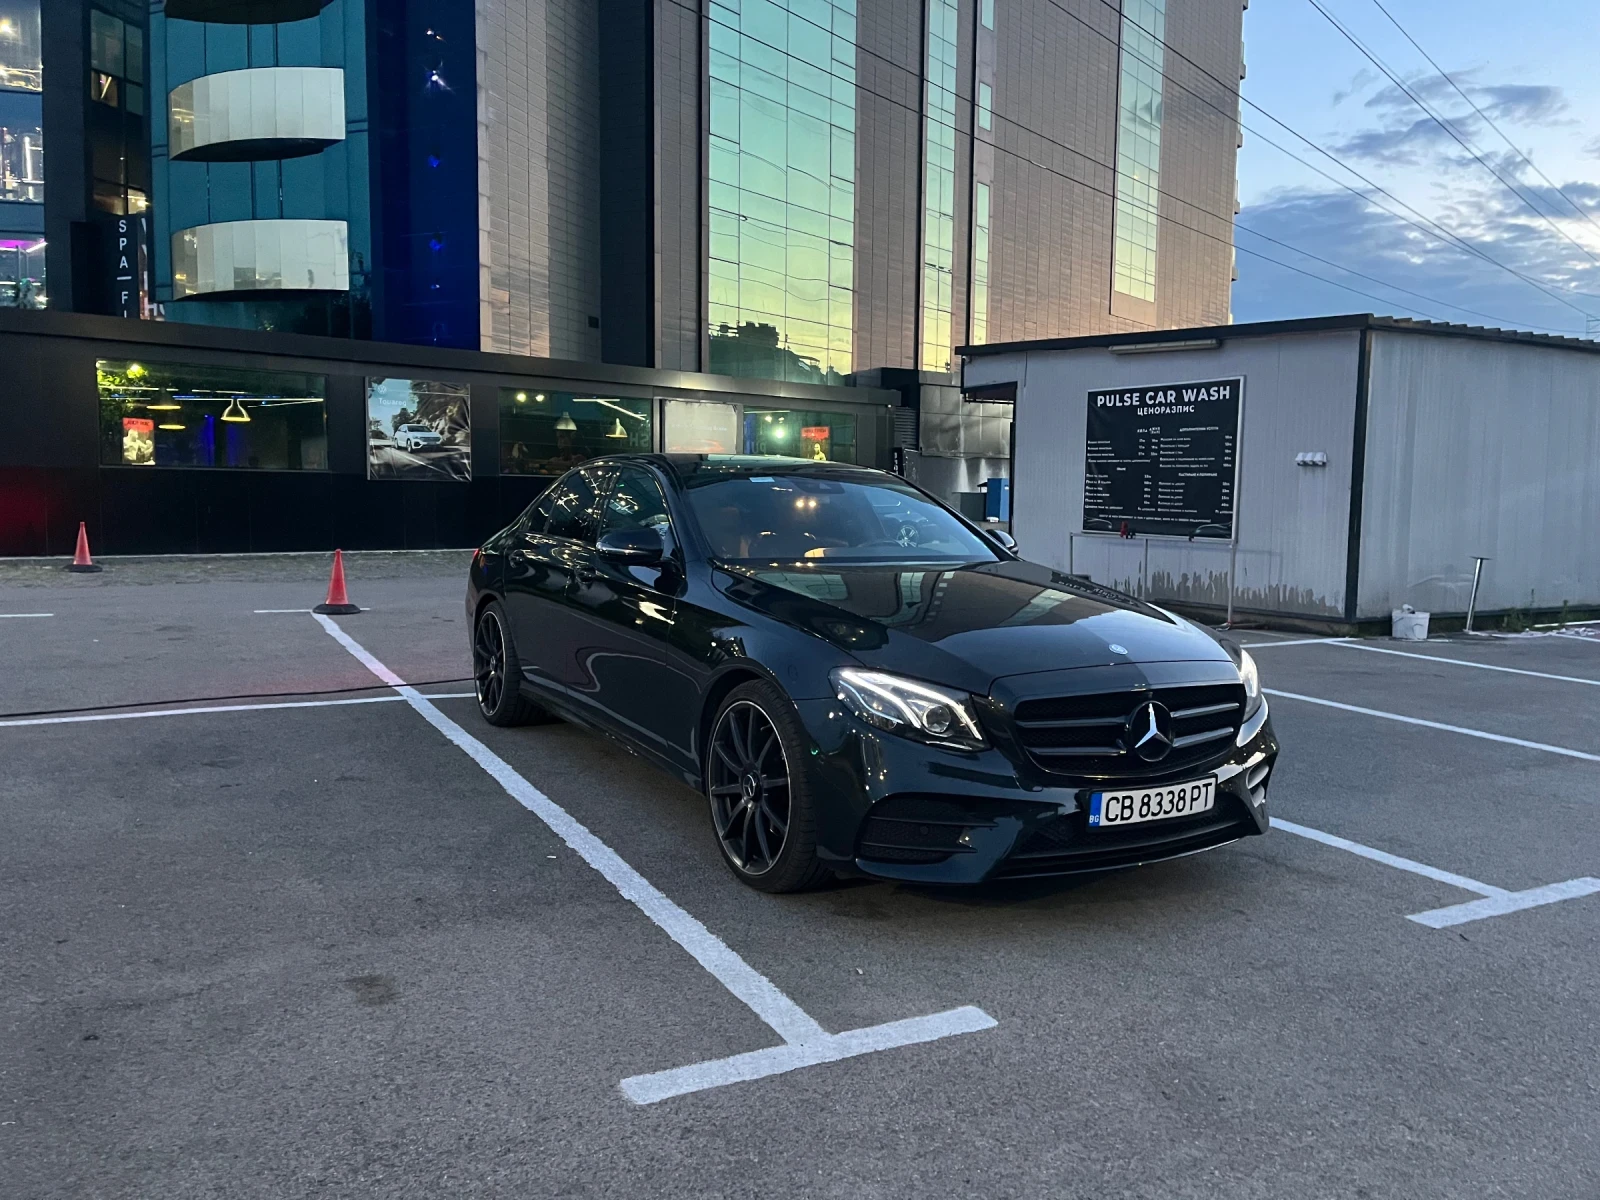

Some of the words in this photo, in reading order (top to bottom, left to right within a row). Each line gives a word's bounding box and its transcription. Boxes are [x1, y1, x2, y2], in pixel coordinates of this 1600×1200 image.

[119, 219, 128, 268] SPA
[1097, 393, 1140, 407] PULSE
[1145, 390, 1176, 405] CAR
[1182, 385, 1230, 402] WASH
[378, 397, 407, 407] Touareg
[1137, 405, 1195, 416] ЦЕНОРАЗПИС
[1089, 815, 1099, 823] BG
